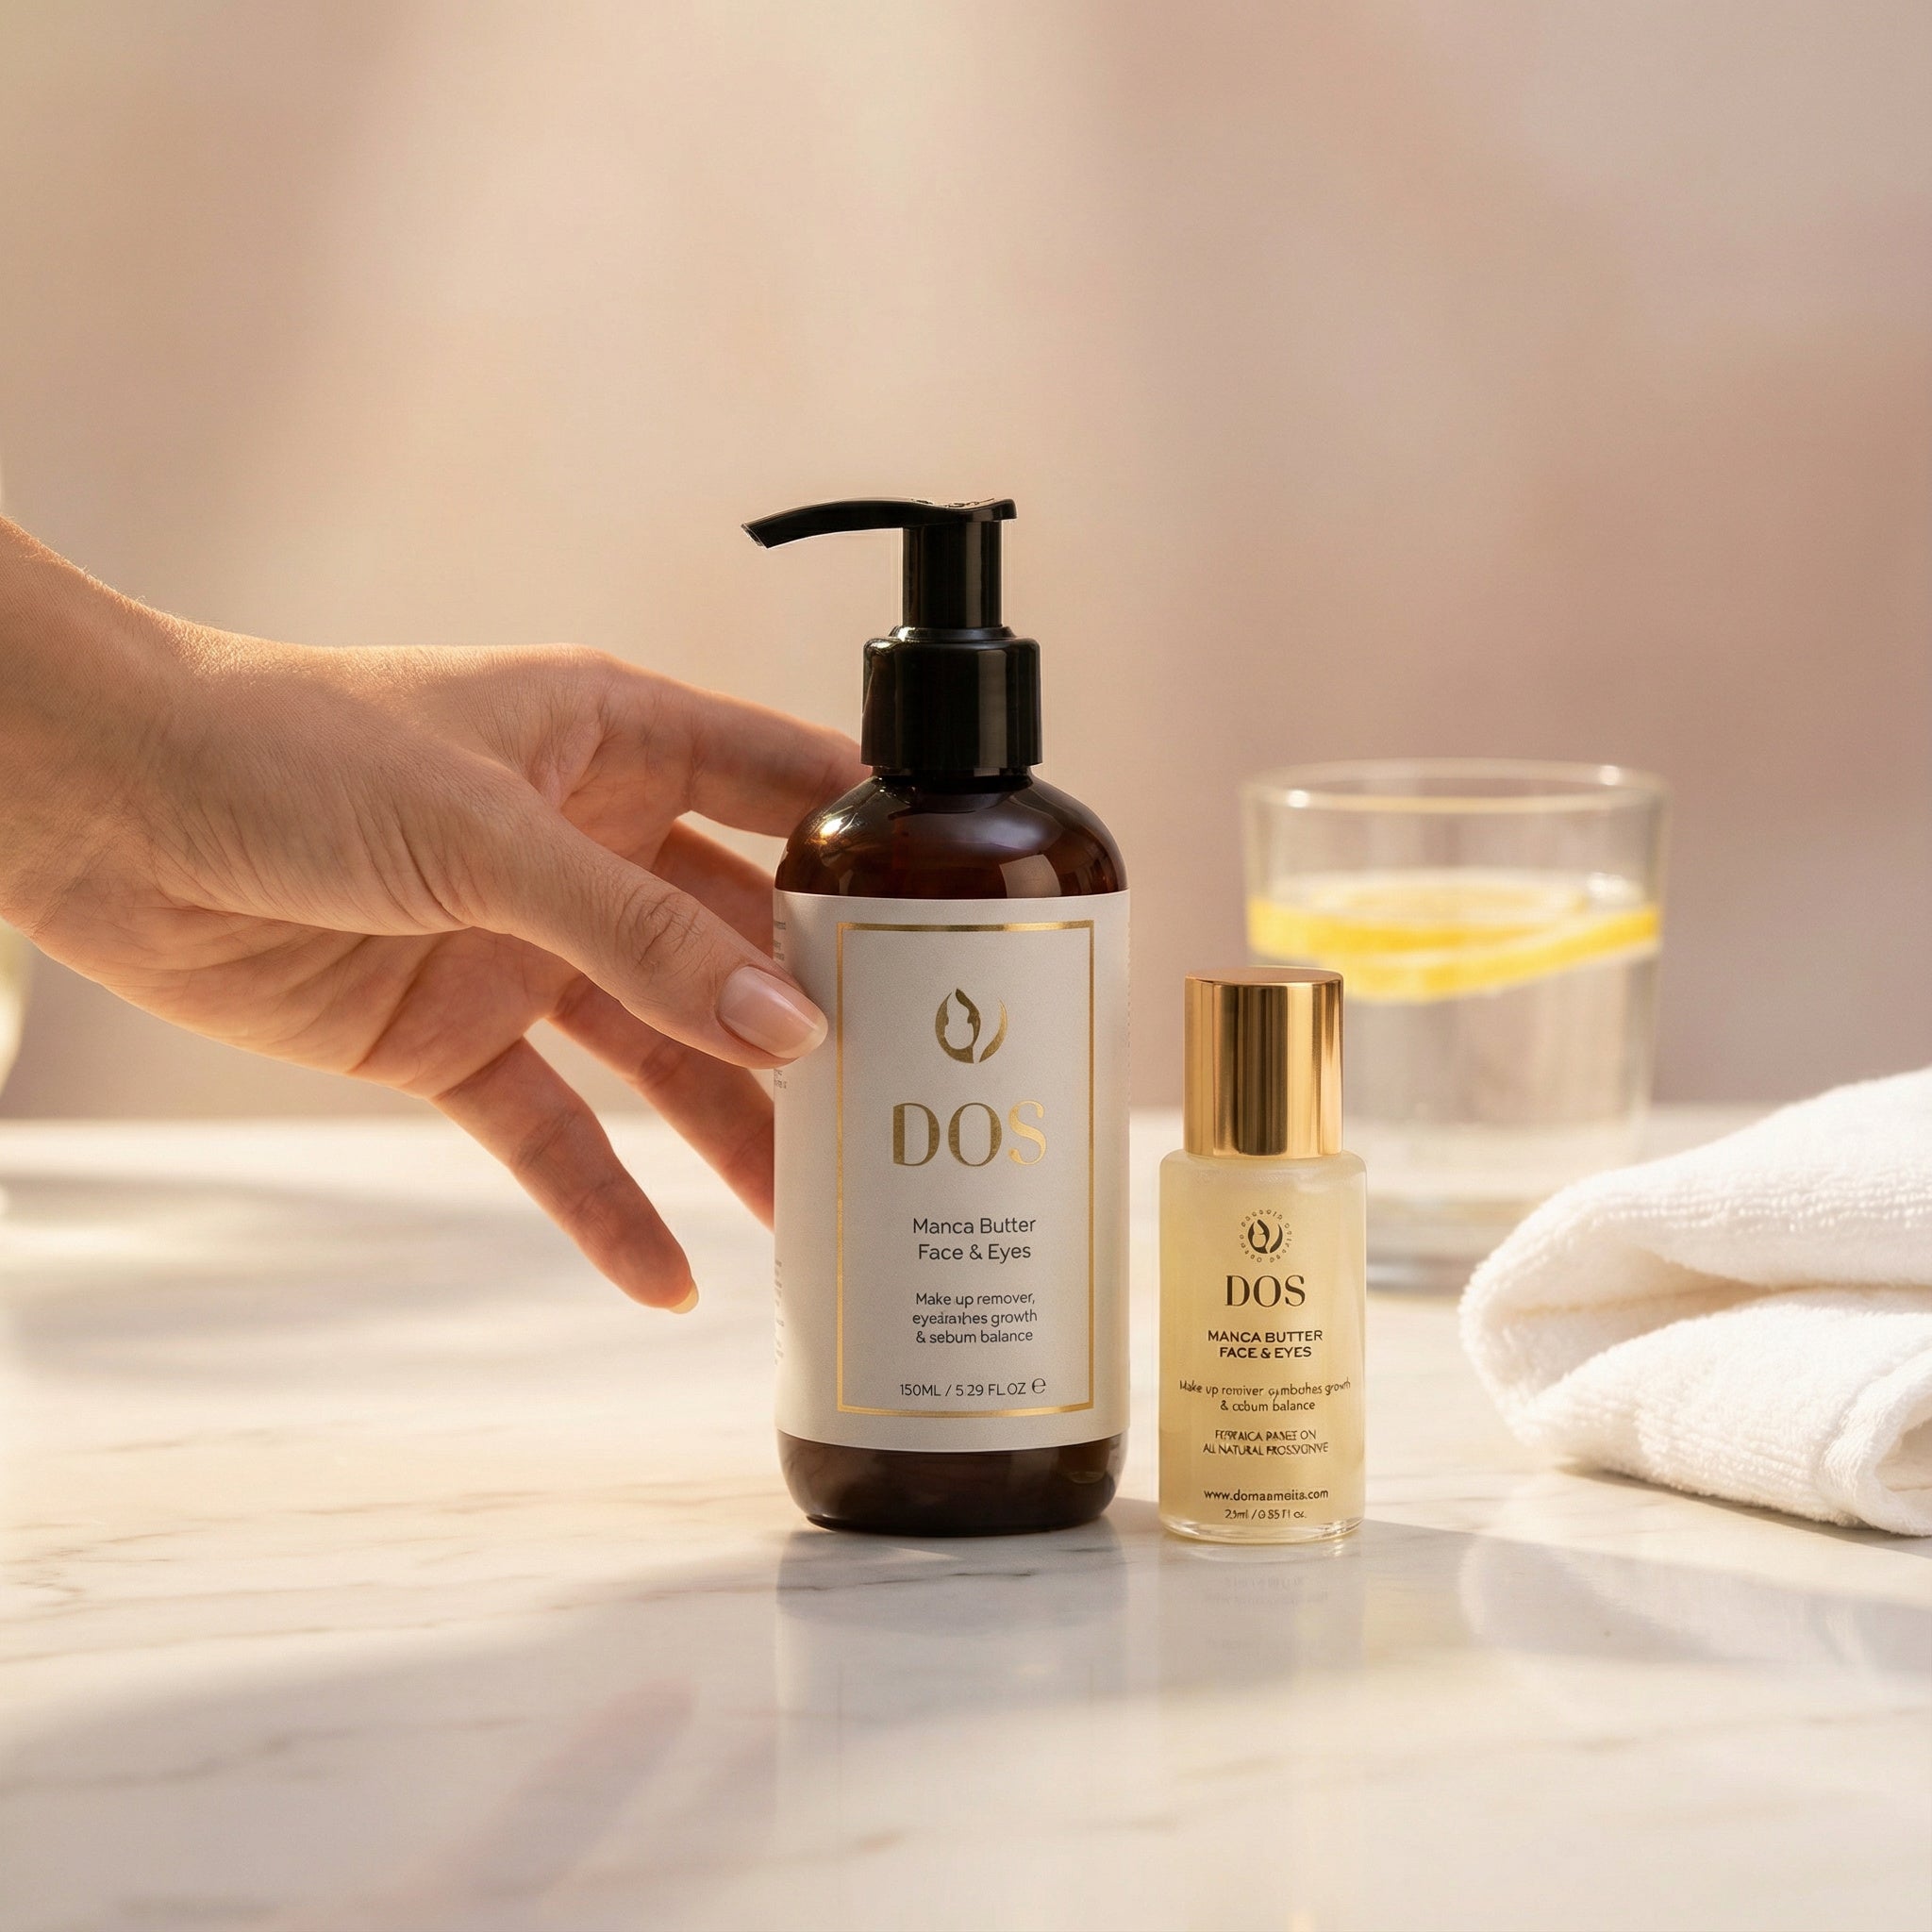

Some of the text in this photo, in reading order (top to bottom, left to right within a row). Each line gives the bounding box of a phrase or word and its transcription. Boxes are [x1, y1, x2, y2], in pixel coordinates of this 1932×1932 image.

[892, 1100, 1047, 1167] DOS
[912, 1217, 1037, 1234] Manca Butter
[918, 1243, 1031, 1264] Face & Eyes
[1224, 1274, 1306, 1307] DOS
[915, 1292, 1035, 1308] Make up remover,
[991, 1308, 1038, 1327] growth
[915, 1330, 1033, 1343] & sebum balance
[1208, 1330, 1323, 1342] MANCA BUTTER
[1220, 1347, 1311, 1358] FACE & EYES
[900, 1384, 941, 1396] 150ML
[944, 1384, 952, 1397] /
[1273, 1400, 1316, 1411] balance
[1218, 1444, 1264, 1456] NATURAL
